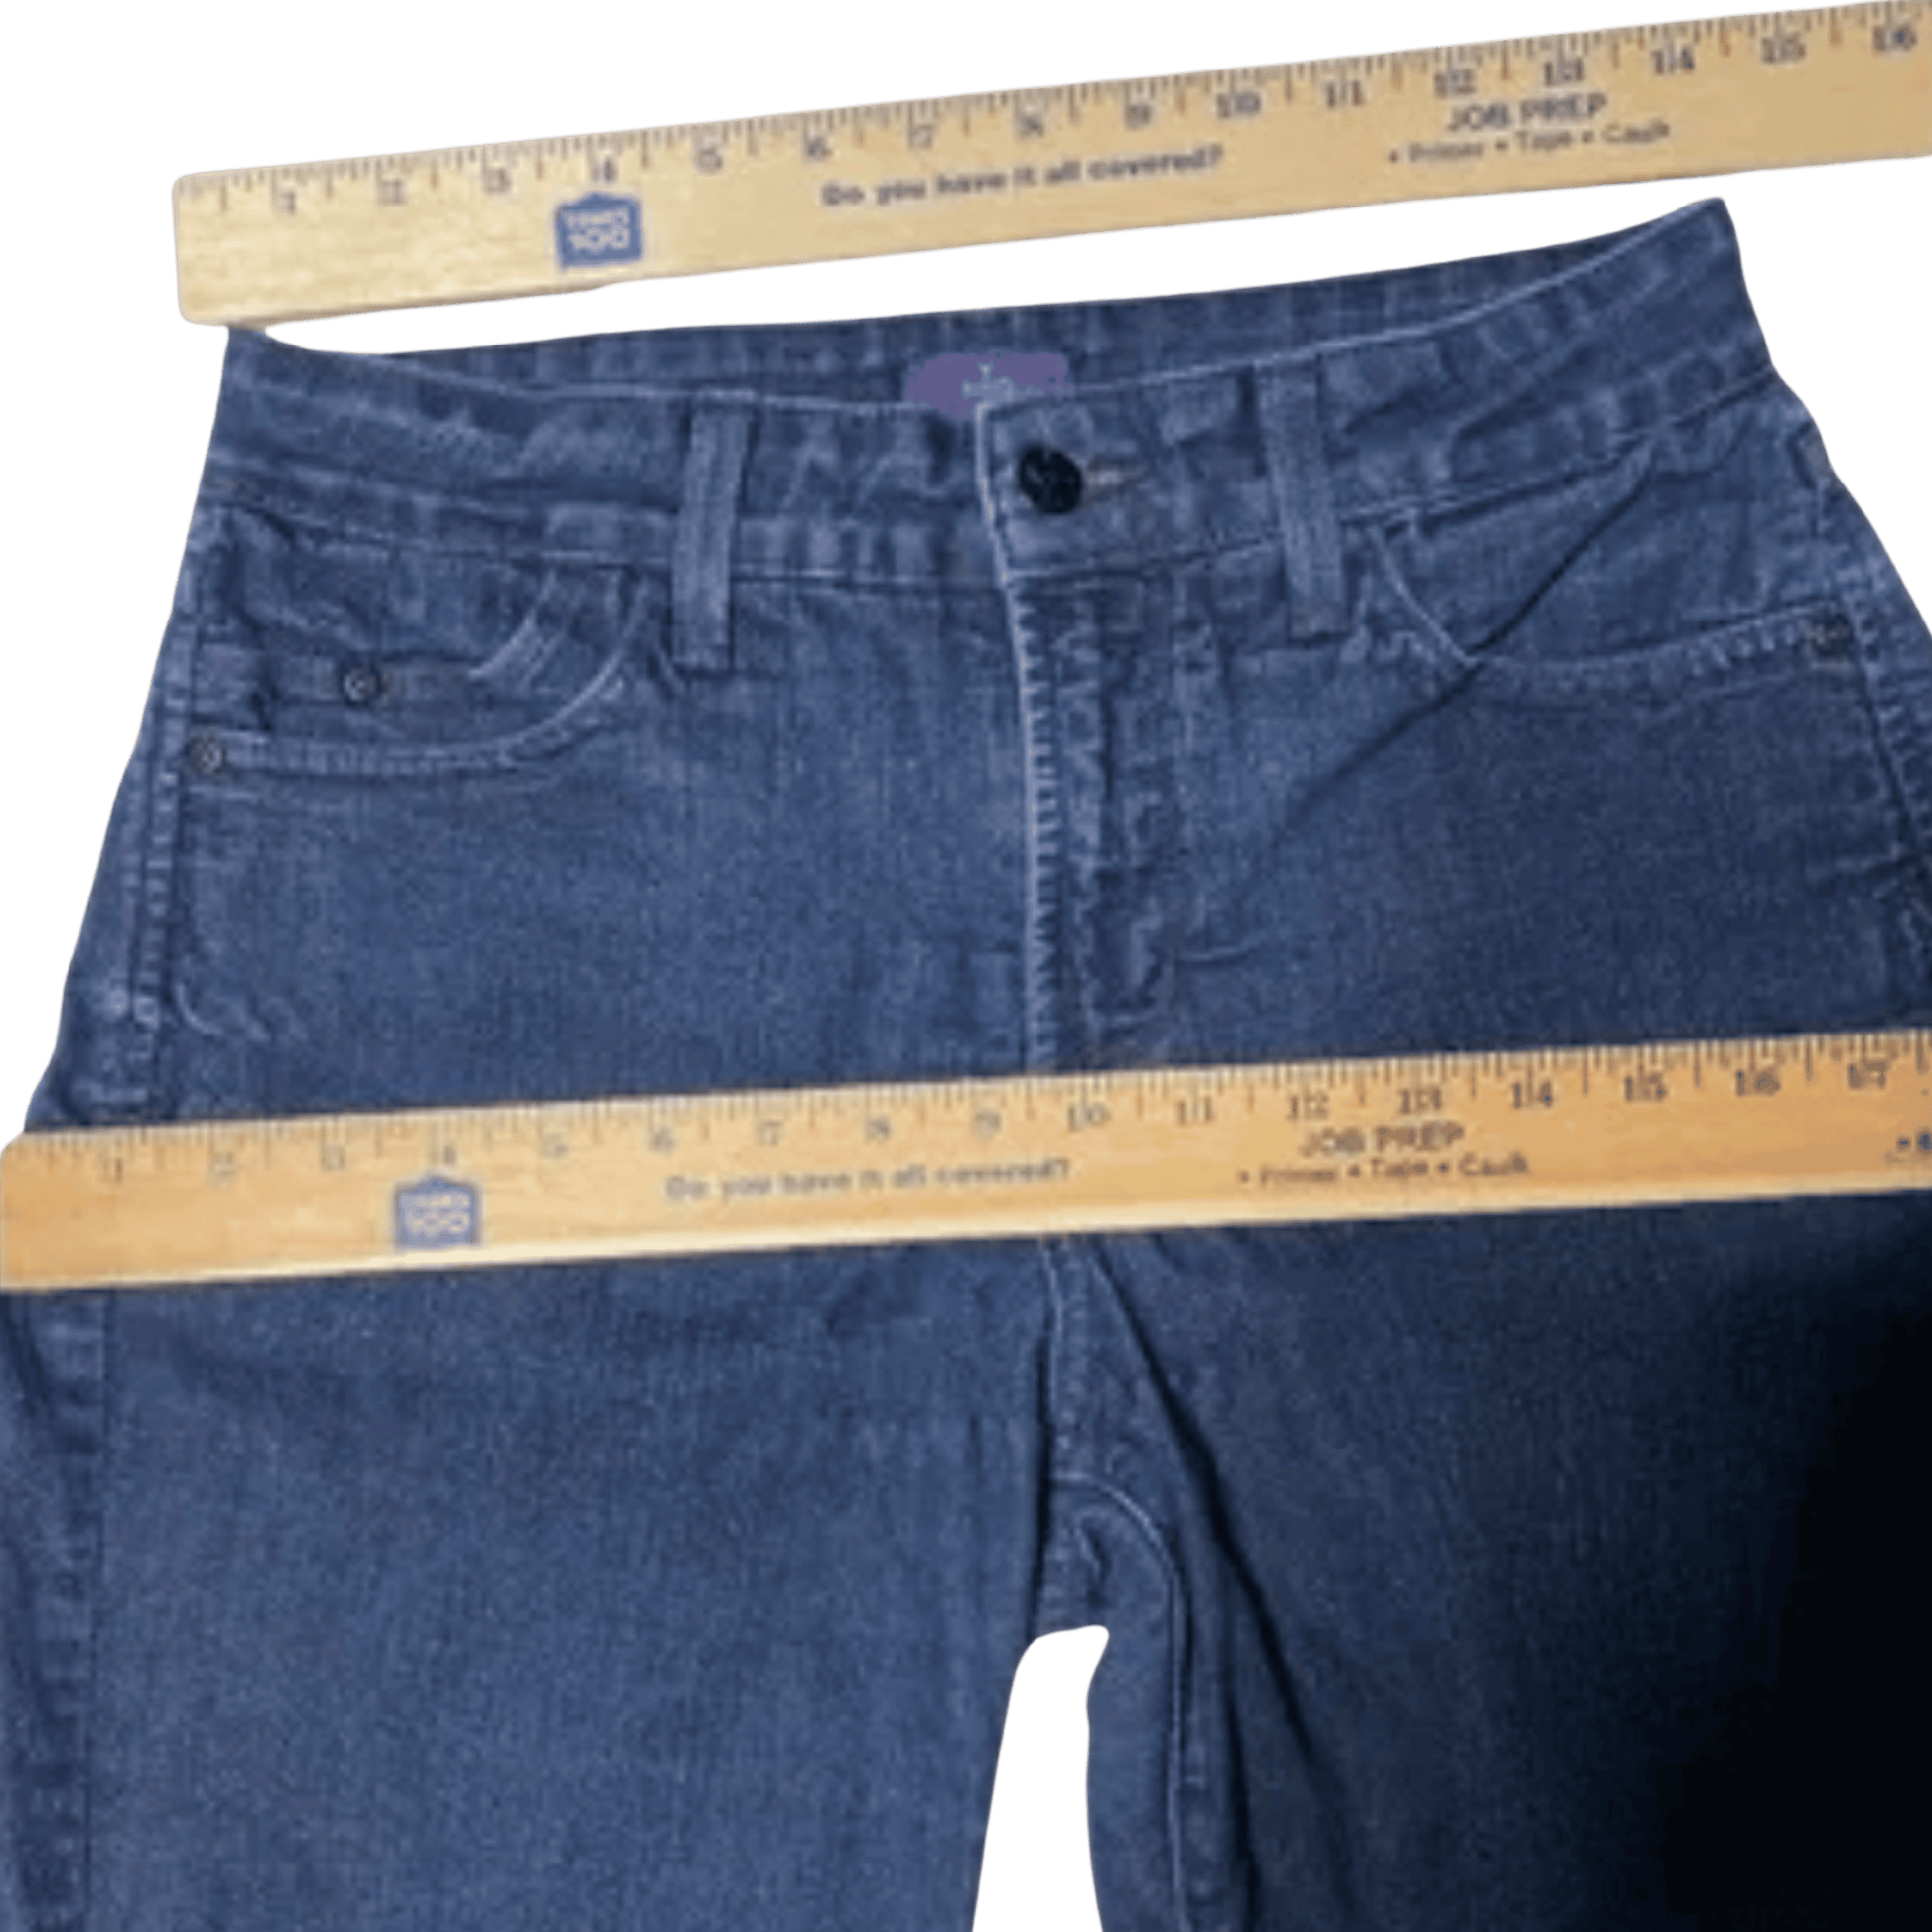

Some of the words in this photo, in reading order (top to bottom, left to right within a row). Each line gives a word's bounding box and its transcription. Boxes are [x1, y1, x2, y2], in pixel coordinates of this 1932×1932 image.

[1217, 90, 1261, 119] 10
[1324, 80, 1364, 107] 11
[1434, 69, 1476, 97] 12
[1544, 58, 1585, 86] 13
[1651, 45, 1695, 75] 14
[1761, 35, 1806, 65] 15
[1872, 24, 1917, 53] 16
[1447, 103, 1510, 131] JOB
[1519, 92, 1607, 124] PREP
[821, 181, 864, 205] Do
[876, 180, 926, 205] you
[937, 171, 1006, 194] have
[1013, 165, 1037, 186] it
[1044, 158, 1081, 182] all
[1087, 142, 1224, 181] covered?
[1298, 1126, 1365, 1156] JOB
[1373, 1121, 1465, 1152] PREP
[666, 1175, 708, 1200] Do
[721, 1177, 771, 1205] you
[780, 1171, 851, 1195] have
[892, 1163, 927, 1189] all
[935, 1156, 1070, 1185] covered?
